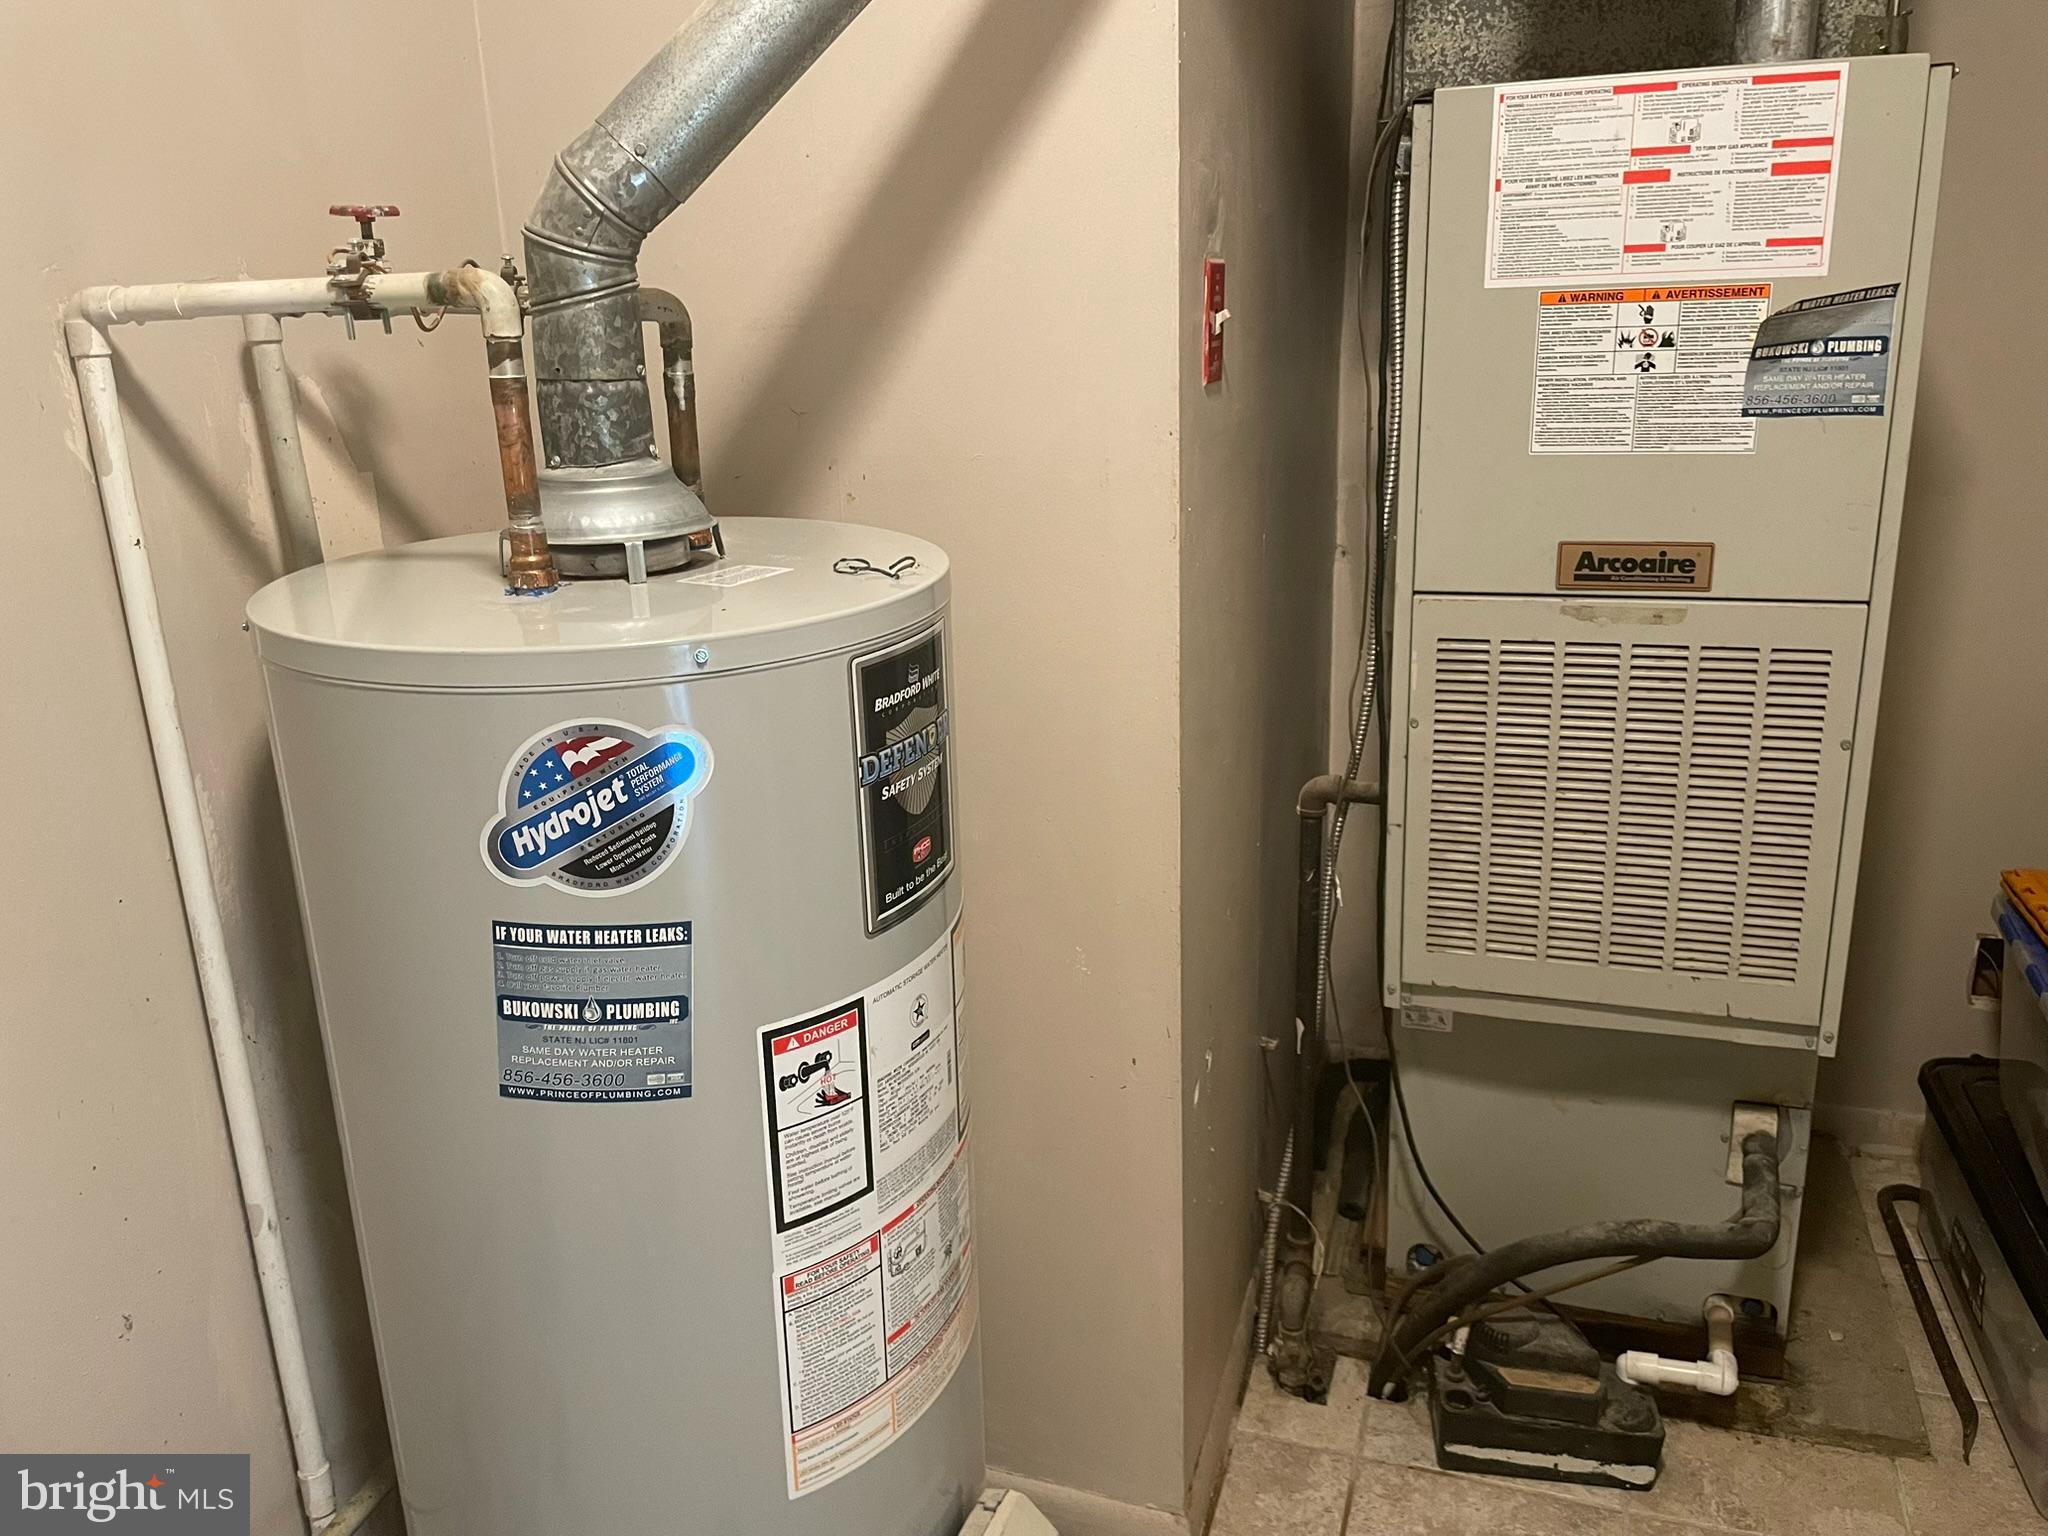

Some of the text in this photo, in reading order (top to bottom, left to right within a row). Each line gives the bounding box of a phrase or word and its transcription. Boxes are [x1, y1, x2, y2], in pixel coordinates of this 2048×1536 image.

[1570, 292, 1624, 302] WARNING
[1666, 287, 1764, 299] AVERTISSEMENT
[1802, 286, 1895, 309] WATER HEATER LEAKS:
[1755, 340, 1882, 358] BUKOWSKI PLUMBING
[1812, 382, 1842, 390] AND/OR
[1746, 394, 1837, 405] 856-456-3600
[1574, 551, 1696, 574] Arcoaire
[875, 668, 940, 712] BRADFORD WHITE
[542, 736, 552, 747] IN
[625, 762, 650, 779] TOTAL
[630, 752, 683, 788] PERFORMANCE
[881, 753, 944, 801] SAFETY SYSTEM
[533, 757, 628, 810] EQUIPPED WITH
[634, 776, 664, 796] SYSTEM
[512, 777, 628, 857] Hydrojet
[580, 812, 645, 852] FEATURING
[584, 821, 657, 866] Reduced Sediment Buildup
[595, 834, 656, 871] Lower Operating Costs
[610, 847, 652, 874] More Hot Water
[552, 871, 609, 889] BRADFORD
[885, 886, 904, 903] Built
[906, 881, 914, 891] to
[915, 874, 924, 885] be
[926, 863, 935, 877] the
[496, 926, 688, 944] IF YOUR WATER HEATER LEAKS:
[873, 983, 902, 1004] AUTOMATIC
[903, 968, 923, 985] STORAGE
[503, 999, 680, 1019] BUKOWSKI PLUMBING
[803, 1019, 848, 1044] DANGER
[522, 1045, 663, 1057] SAME DAY WATER HEATER
[511, 1055, 675, 1068] REPLACEMENT AND/OR REPAIR
[503, 1069, 625, 1087] 856-456-3600
[508, 1087, 681, 1099] WWW.PRINCEOFPLUMBING.COM
